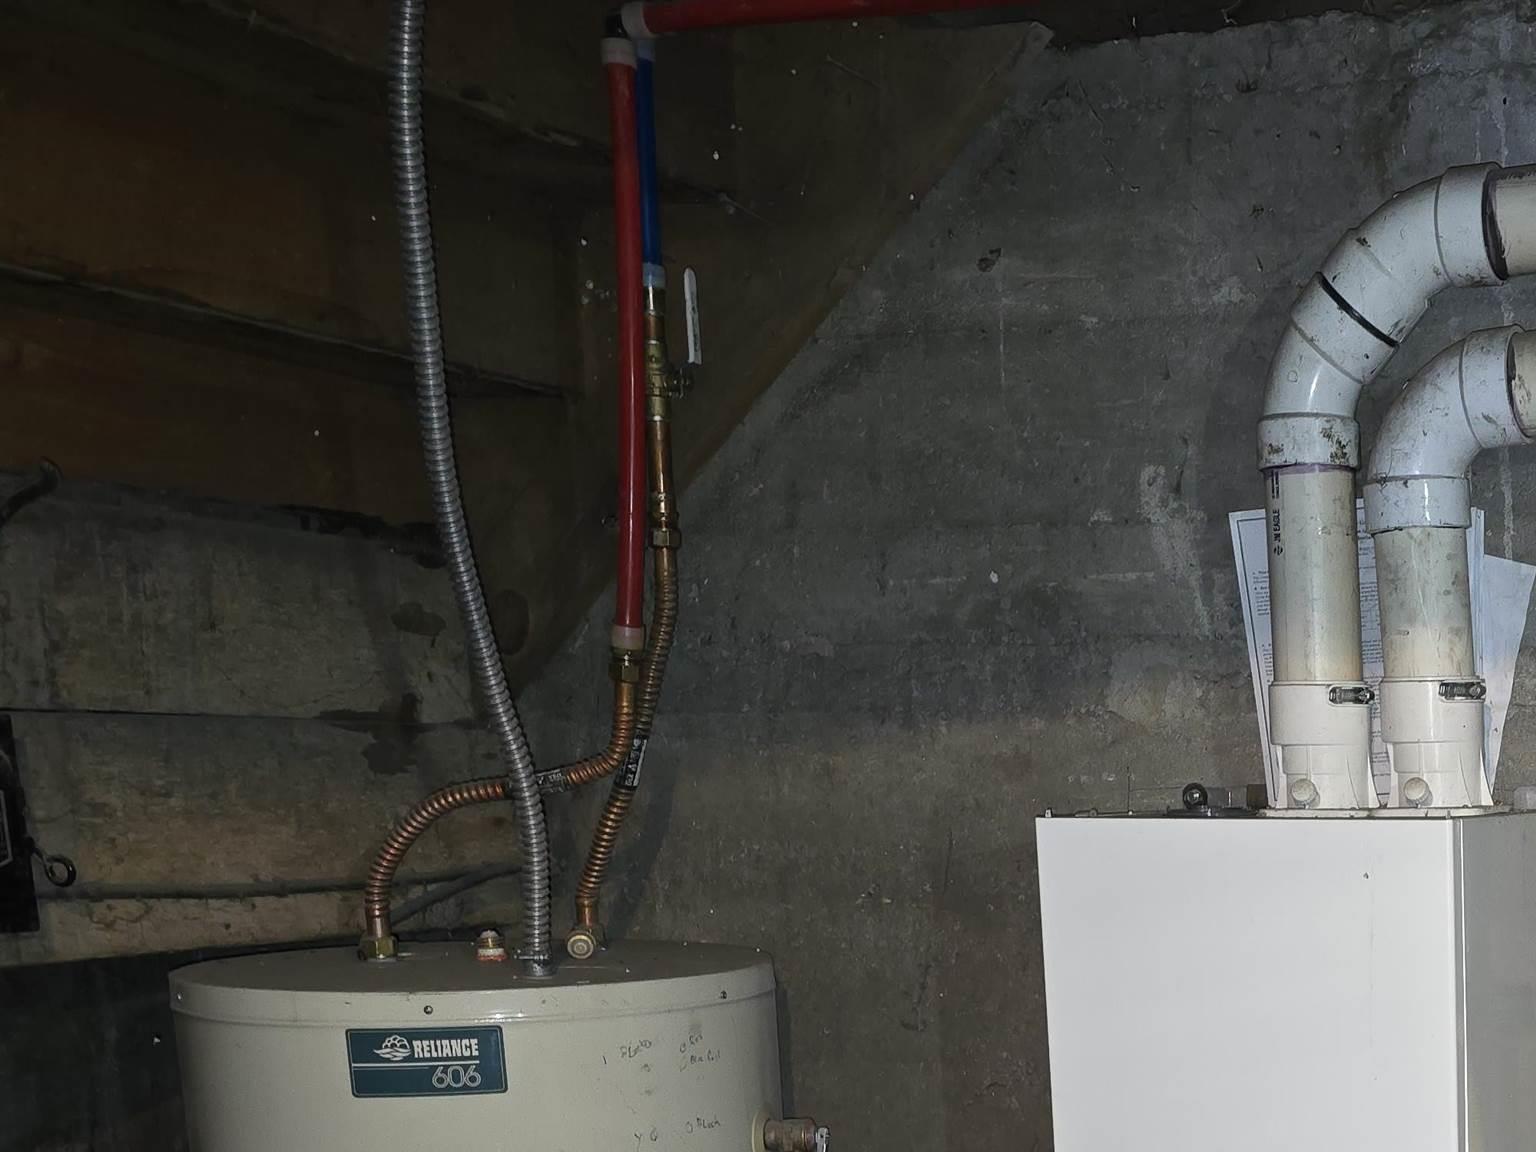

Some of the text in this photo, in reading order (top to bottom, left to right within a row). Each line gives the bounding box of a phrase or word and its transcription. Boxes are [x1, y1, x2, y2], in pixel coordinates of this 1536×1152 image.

[1272, 509, 1281, 532] EAGLE
[412, 1038, 480, 1060] RELIANCE
[431, 1065, 482, 1089] 606
